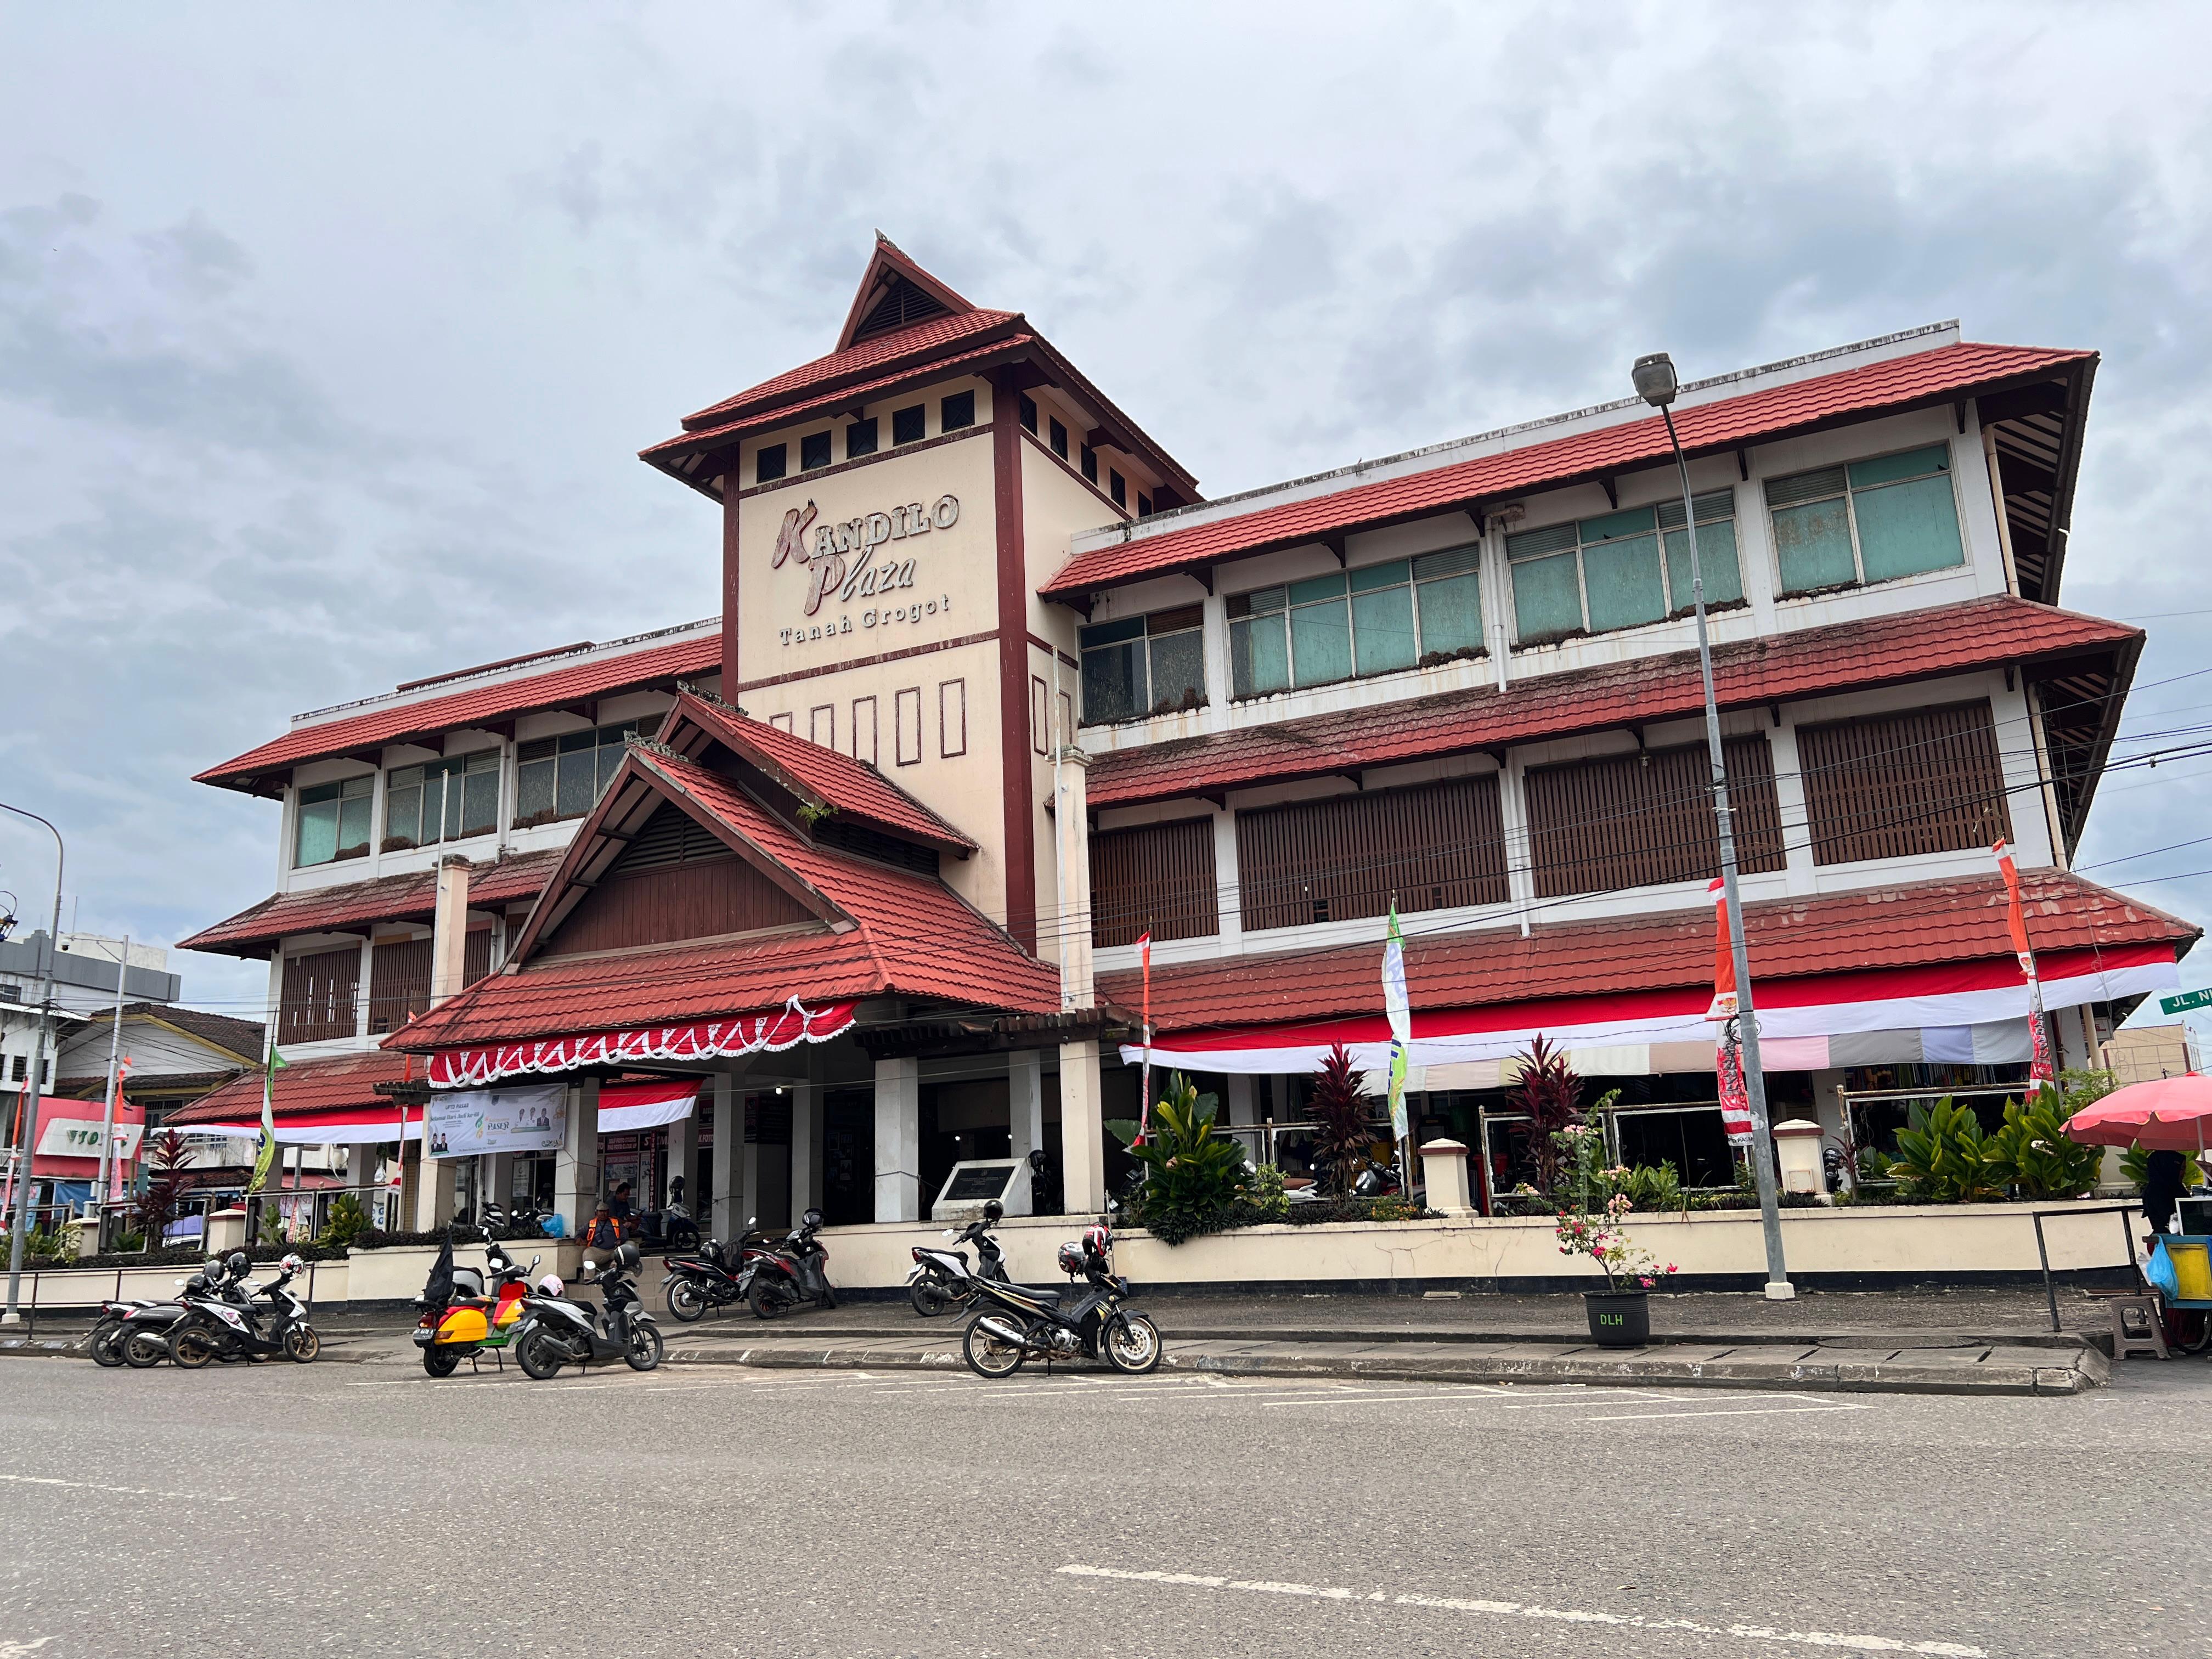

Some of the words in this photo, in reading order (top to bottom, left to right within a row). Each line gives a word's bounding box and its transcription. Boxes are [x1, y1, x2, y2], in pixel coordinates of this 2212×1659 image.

[771, 494, 960, 568] KANDILO
[804, 545, 917, 616] Plaza
[780, 615, 853, 646] Tanah
[861, 593, 950, 628] Grogot
[2173, 996, 2194, 1007] JL.
[1600, 1314, 1623, 1325] DLH
